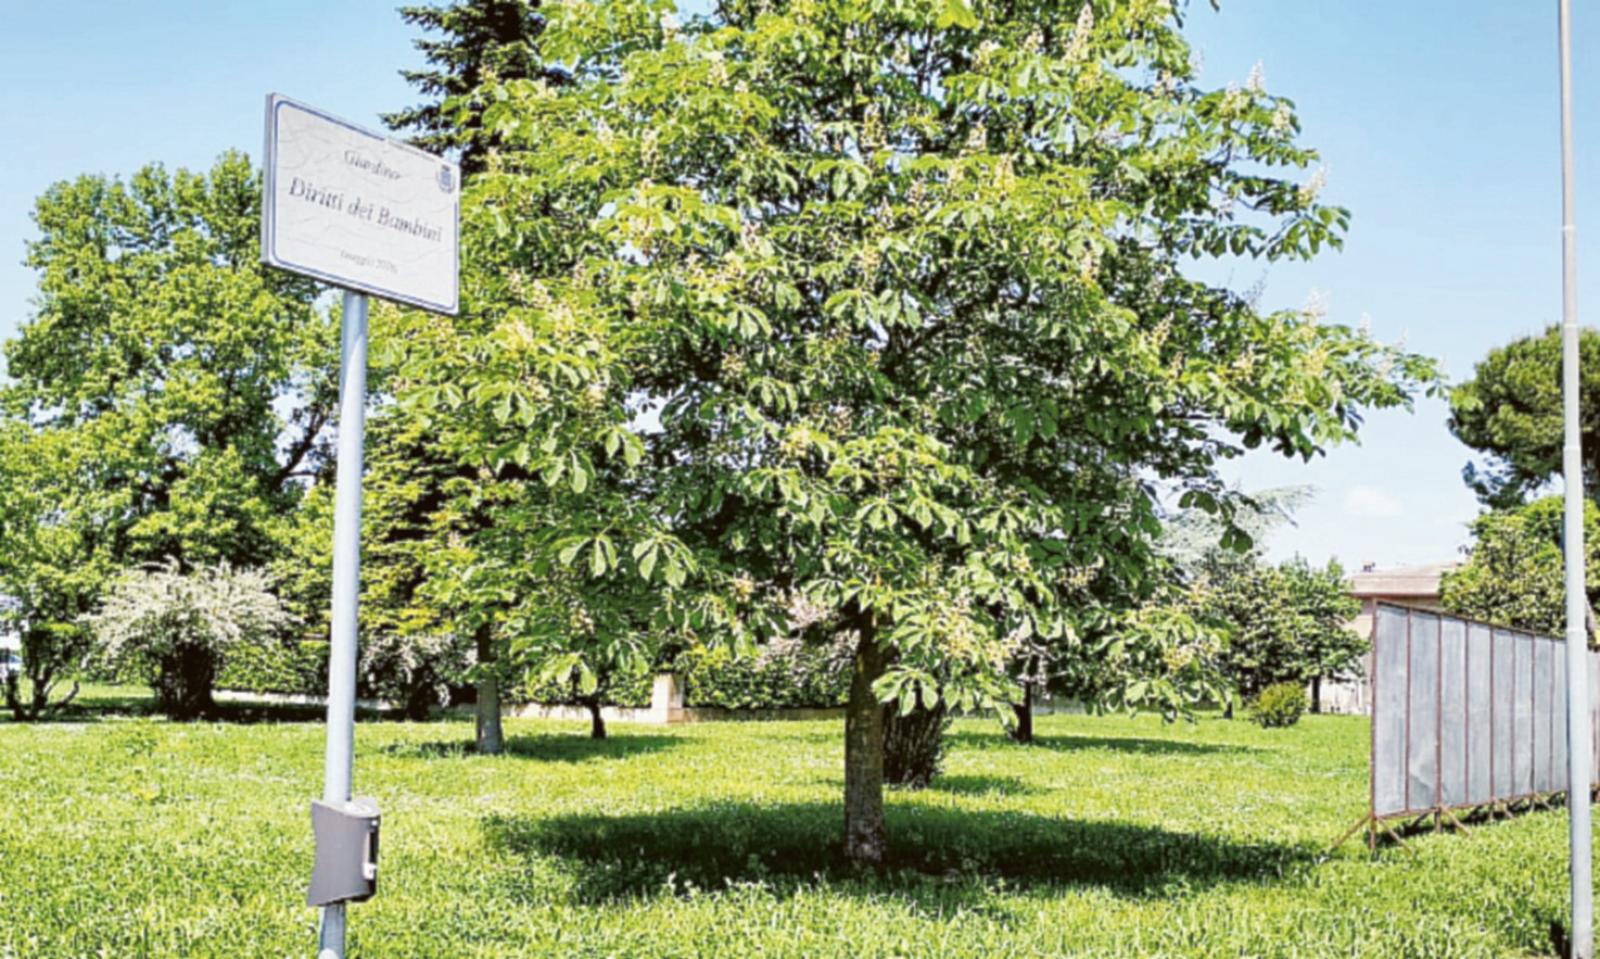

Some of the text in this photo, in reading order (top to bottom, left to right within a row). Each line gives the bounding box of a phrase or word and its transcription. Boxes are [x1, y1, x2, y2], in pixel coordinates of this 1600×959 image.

[289, 177, 442, 243] Diritti dei Bambini
